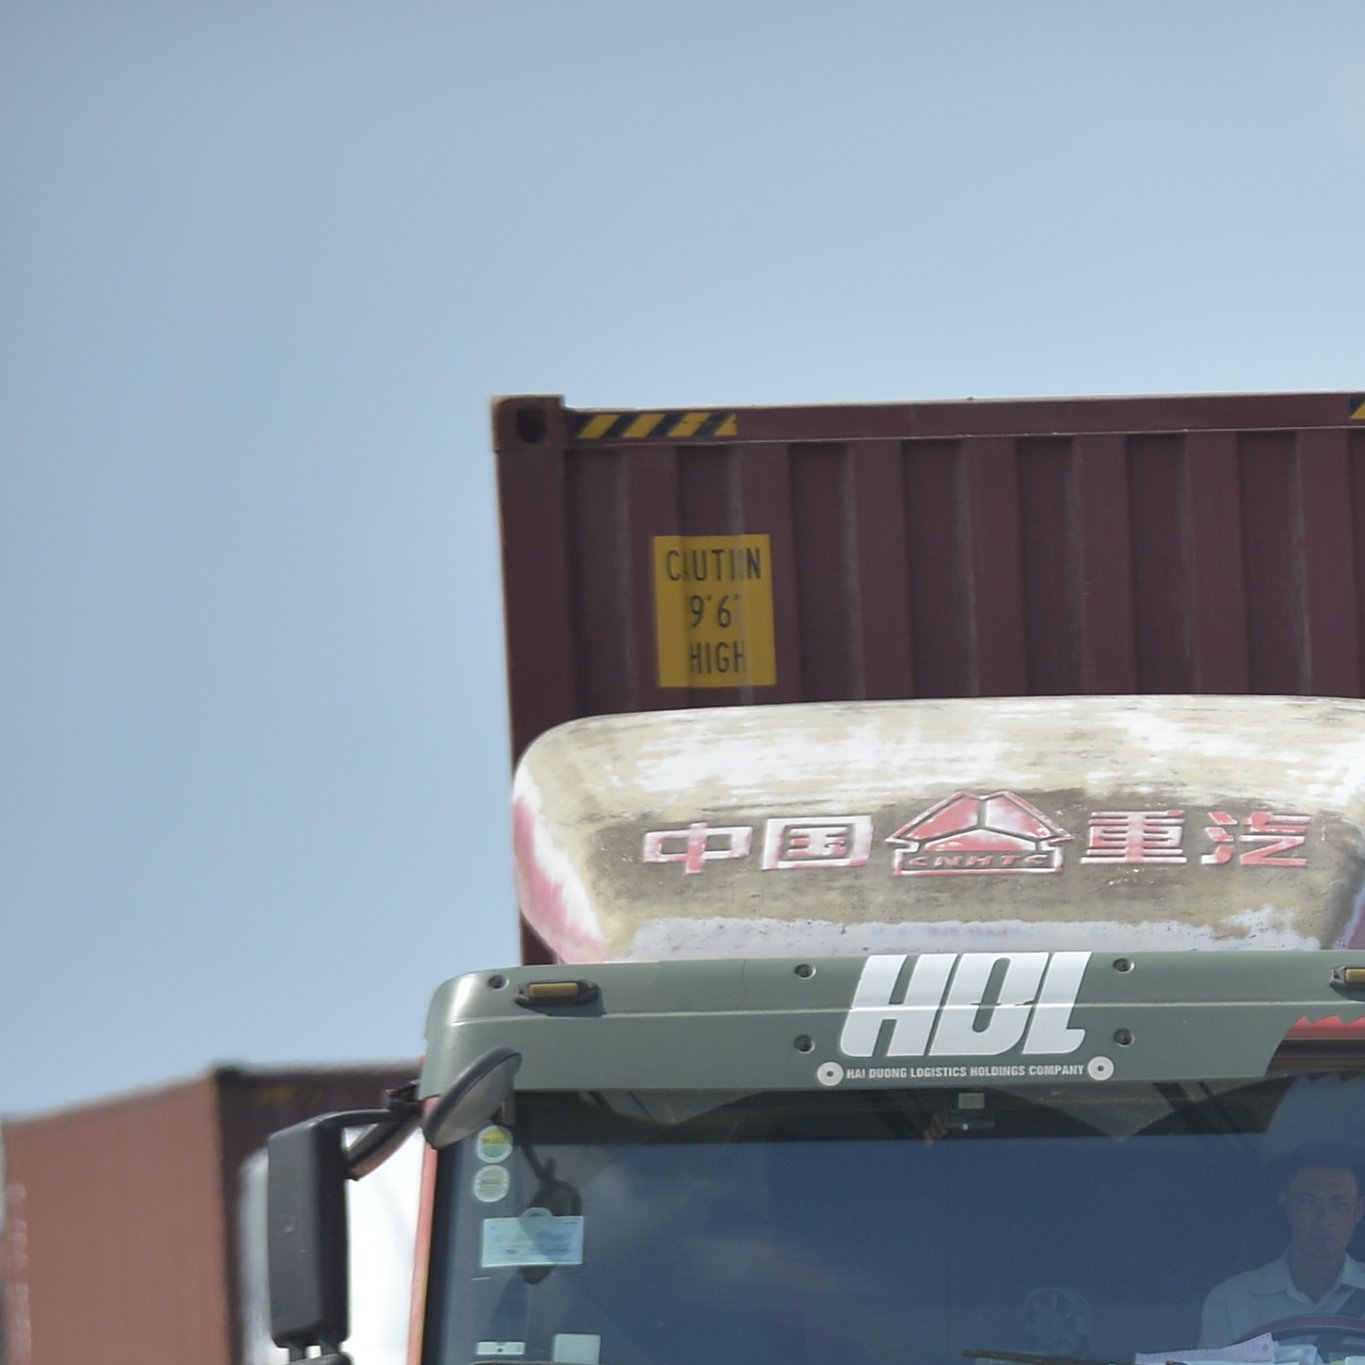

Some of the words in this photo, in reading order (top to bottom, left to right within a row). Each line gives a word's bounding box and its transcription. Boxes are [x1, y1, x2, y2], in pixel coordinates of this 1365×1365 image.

[690, 640, 747, 675] HIGH
[642, 815, 873, 874] 中国
[1080, 809, 1312, 868] 重汽
[908, 853, 1048, 867] CNHTC
[840, 951, 1093, 1057] HDL
[847, 1069, 866, 1080] HAI
[869, 1067, 908, 1079] DUONG
[911, 1066, 967, 1078] LOGISTICS
[970, 1065, 1026, 1077] HOLDINGS
[1029, 1064, 1085, 1076] COMPANY
